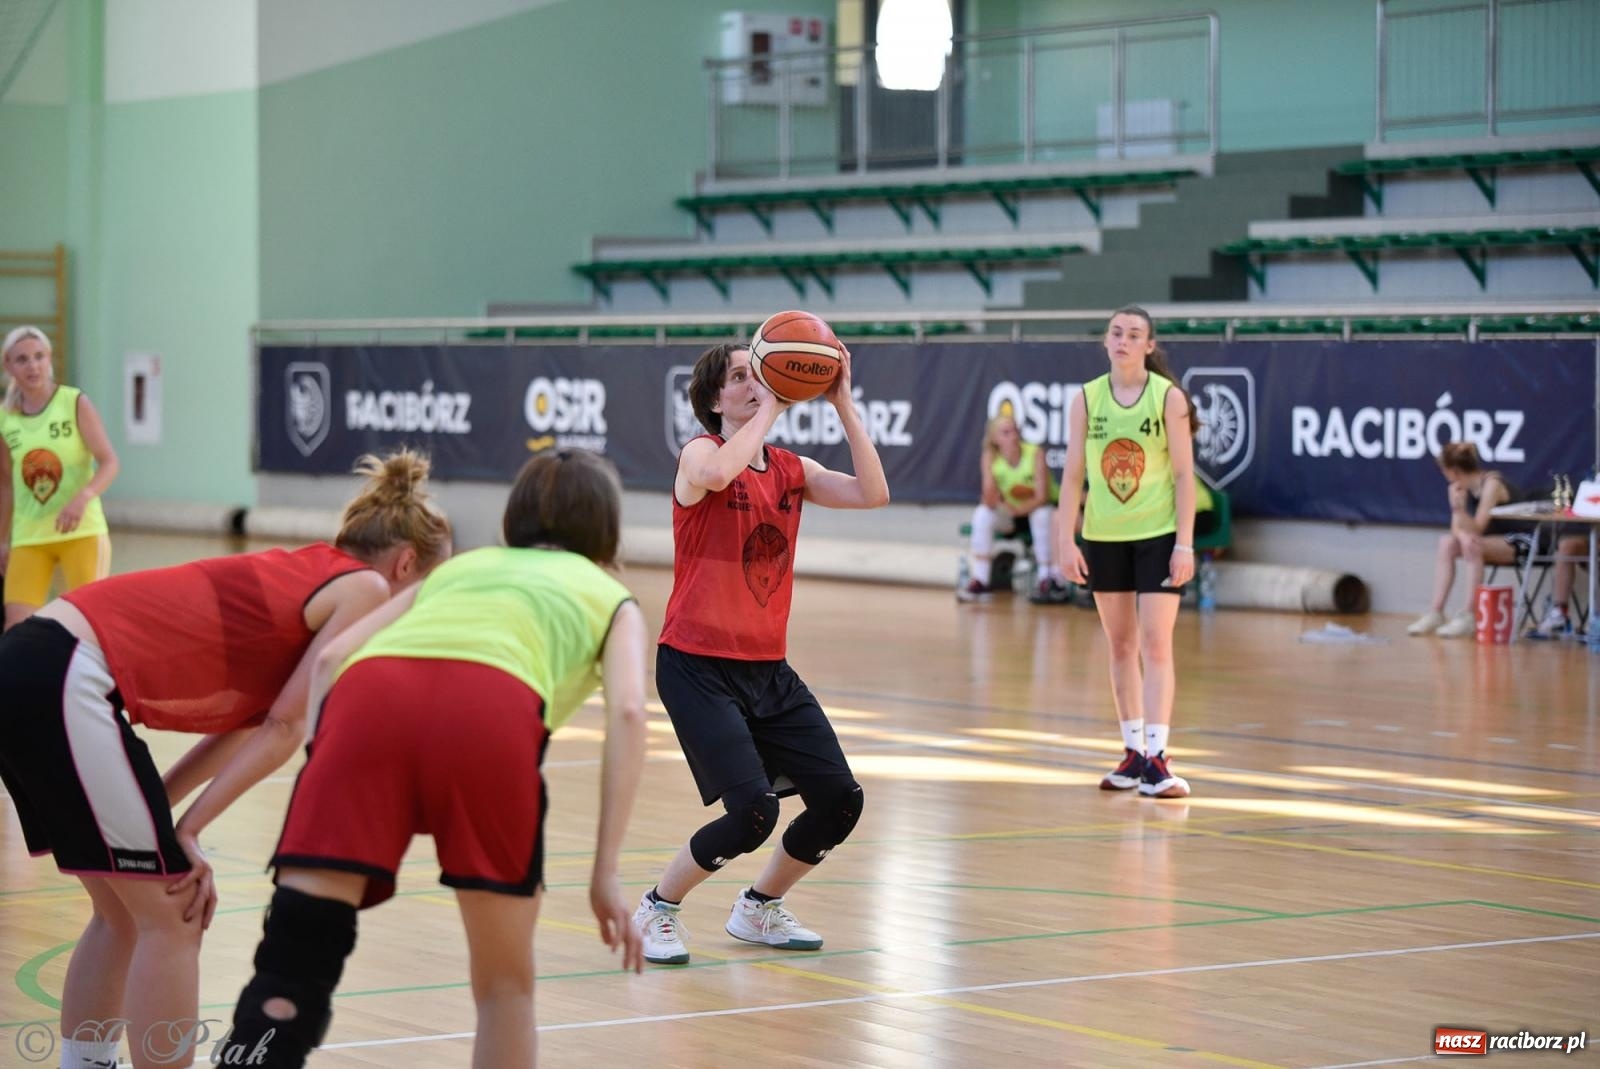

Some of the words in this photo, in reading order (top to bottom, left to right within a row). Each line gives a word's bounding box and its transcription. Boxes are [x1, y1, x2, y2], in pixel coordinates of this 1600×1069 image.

[785, 360, 833, 376] molten
[346, 379, 471, 433] RACIBÓRZ
[763, 387, 912, 446] ACIBRZ
[49, 421, 73, 439] 55
[1139, 417, 1160, 437] 41
[1292, 391, 1526, 463] RACIBÓRZ
